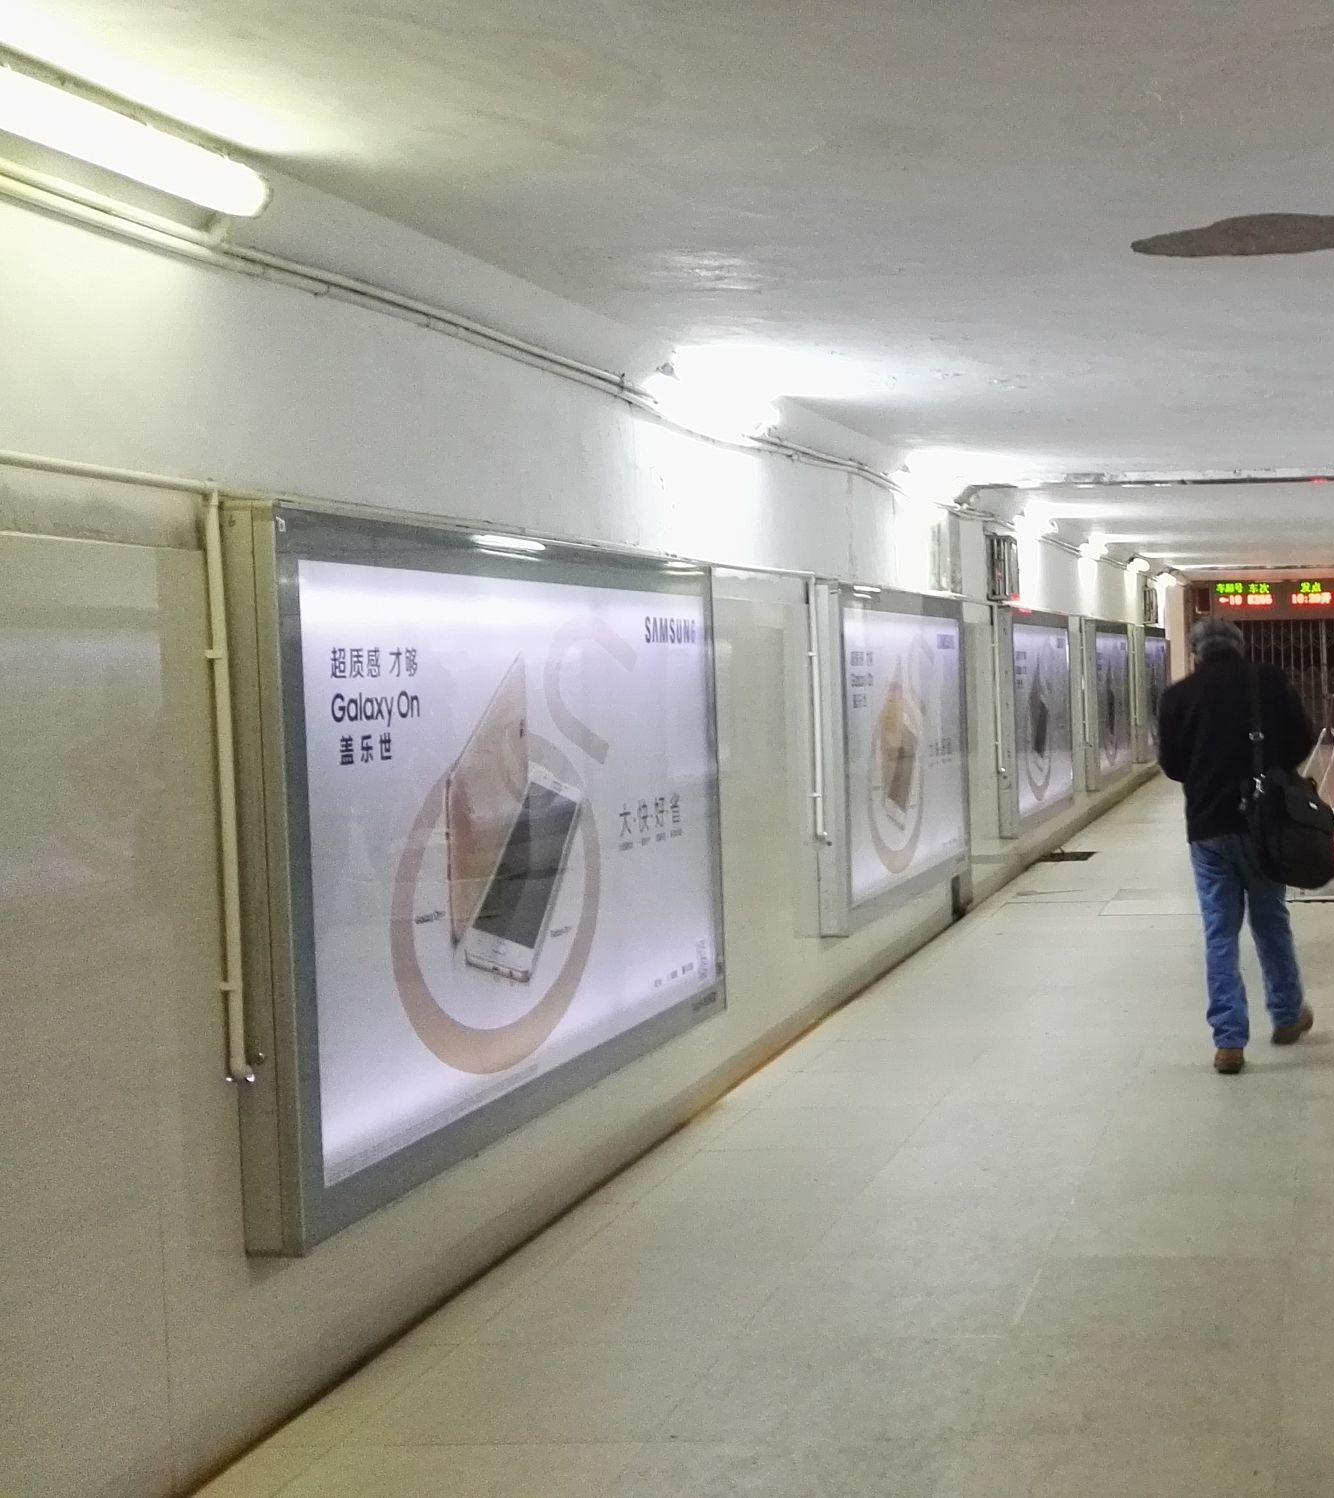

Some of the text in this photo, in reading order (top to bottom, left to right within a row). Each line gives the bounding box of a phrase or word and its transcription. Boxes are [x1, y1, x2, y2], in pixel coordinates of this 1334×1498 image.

[645, 616, 696, 644] SAMSUNG
[330, 647, 418, 678] 超质感 才够
[331, 690, 420, 728] Galaxy On
[340, 732, 392, 766] 盖乐世
